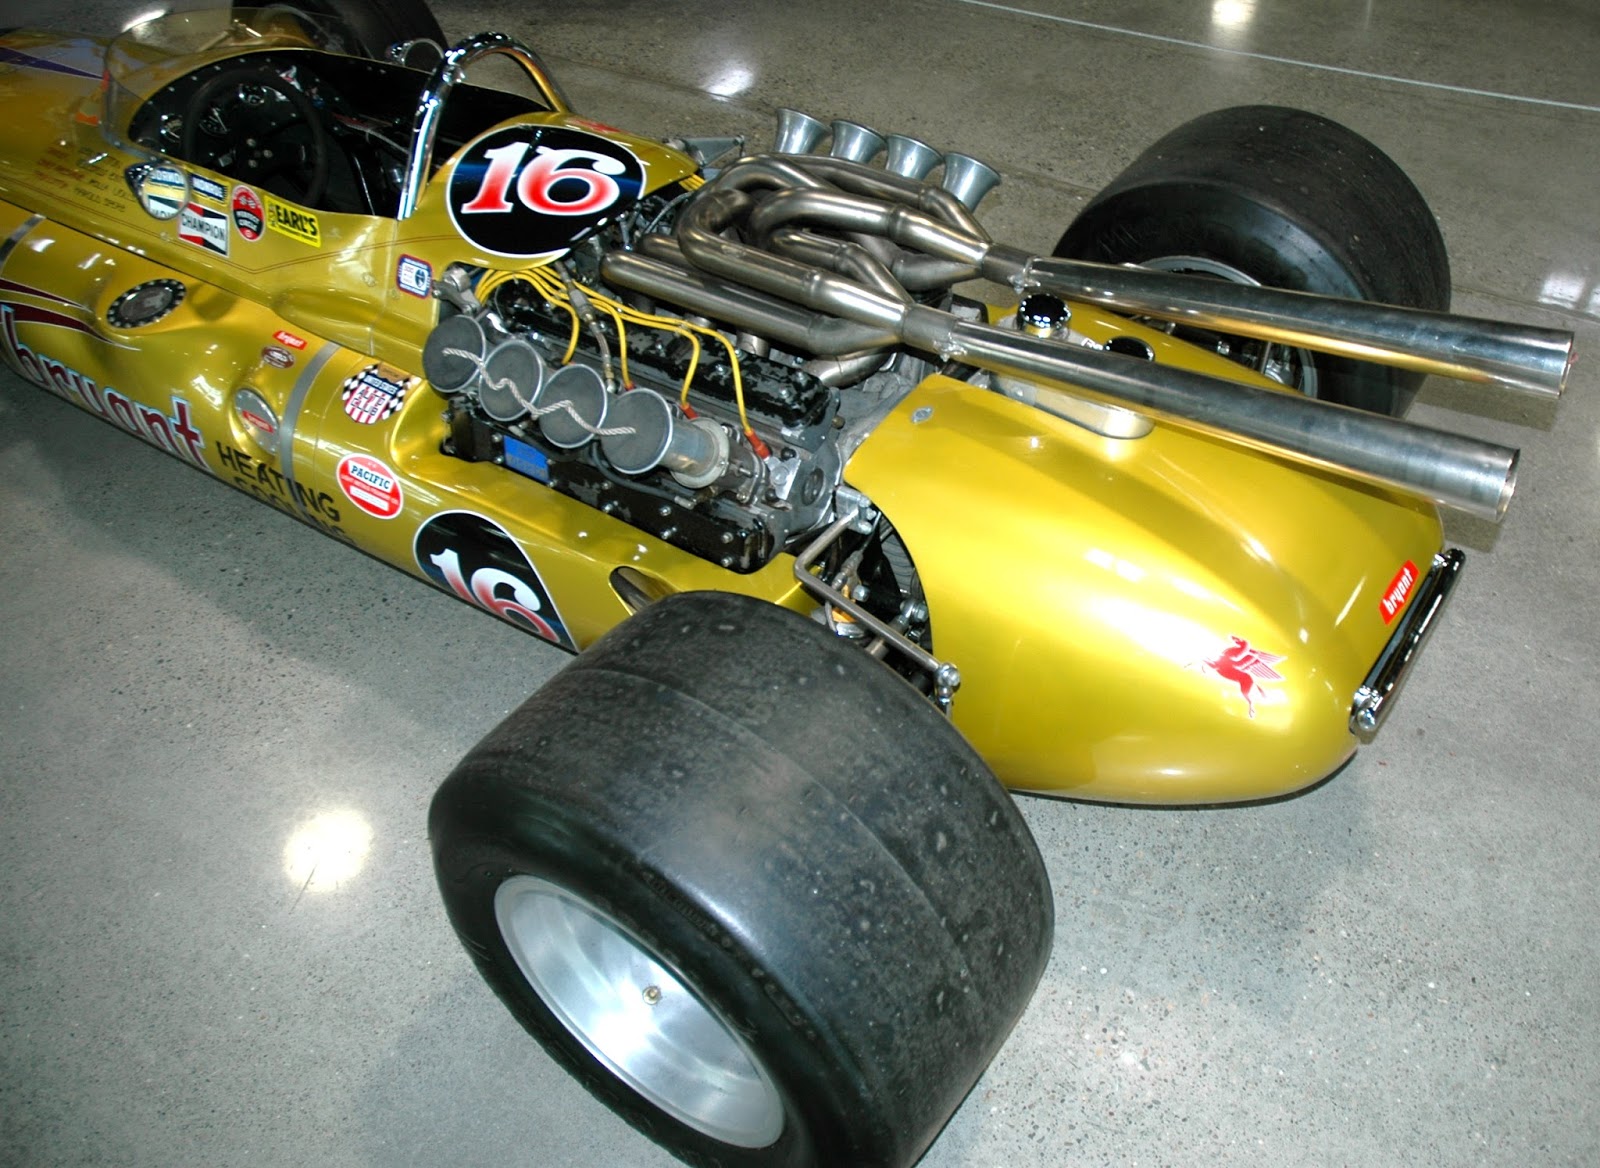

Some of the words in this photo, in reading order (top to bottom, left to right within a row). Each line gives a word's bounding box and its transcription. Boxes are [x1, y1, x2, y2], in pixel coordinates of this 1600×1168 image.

[461, 141, 626, 216] 16
[181, 213, 226, 241] CHAMPION
[275, 205, 318, 236] EARL'S
[350, 397, 379, 416] CLUB
[358, 388, 386, 406] AUTO
[216, 441, 340, 522] HEATING
[351, 465, 390, 489] PACIFIC
[430, 548, 561, 643] 16
[1382, 567, 1413, 615] bryant
